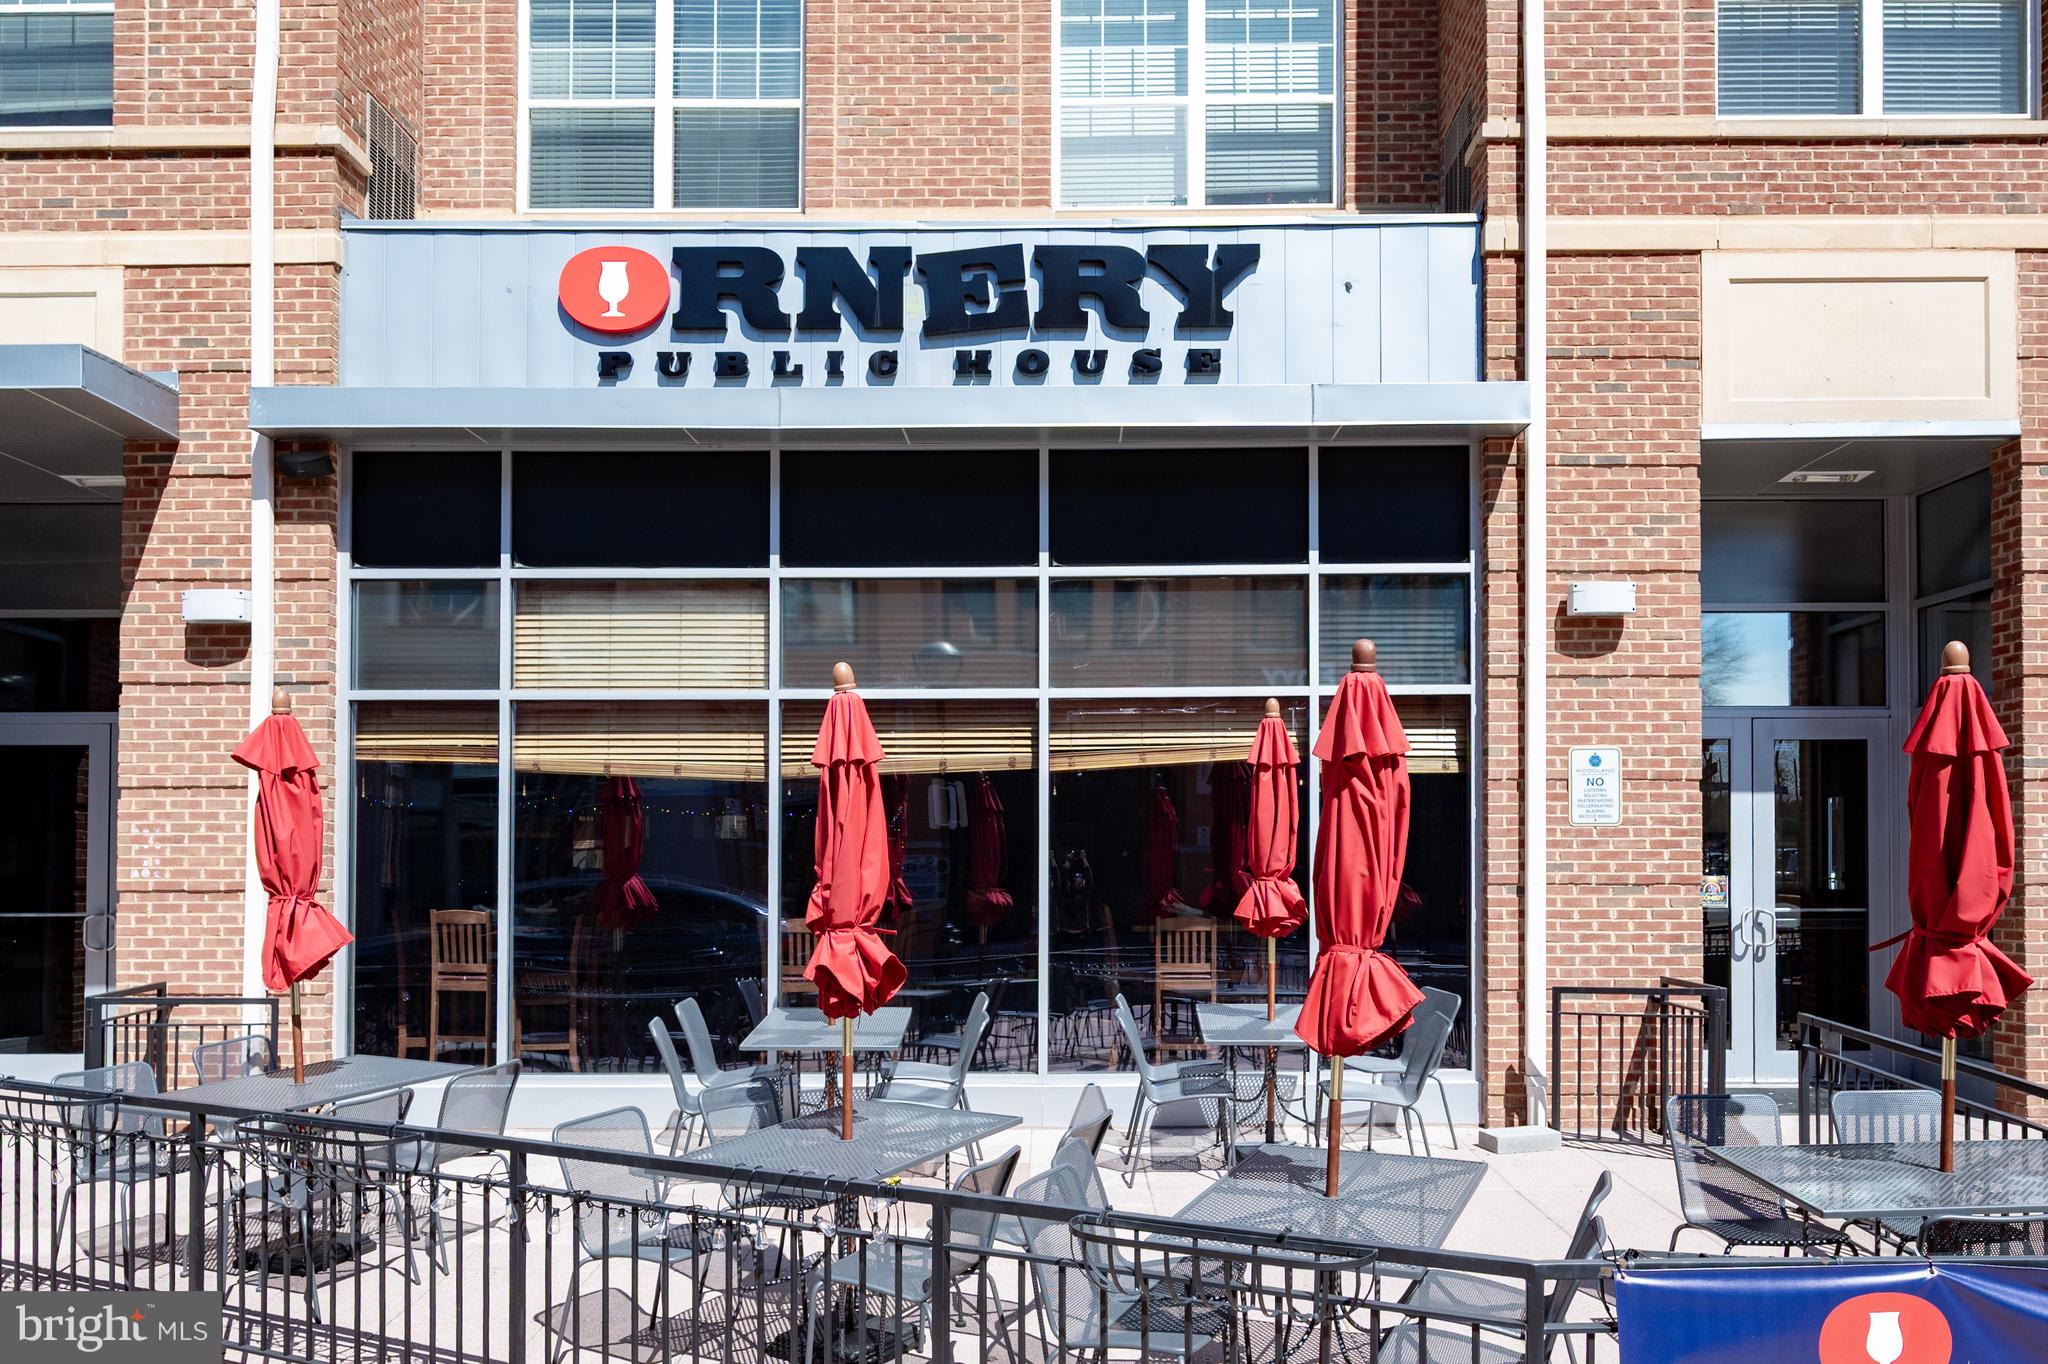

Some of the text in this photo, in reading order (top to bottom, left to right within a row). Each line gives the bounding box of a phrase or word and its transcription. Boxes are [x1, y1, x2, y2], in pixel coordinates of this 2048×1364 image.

[598, 347, 1223, 380] PUBLIC HOUSE
[1586, 778, 1604, 786] NO
